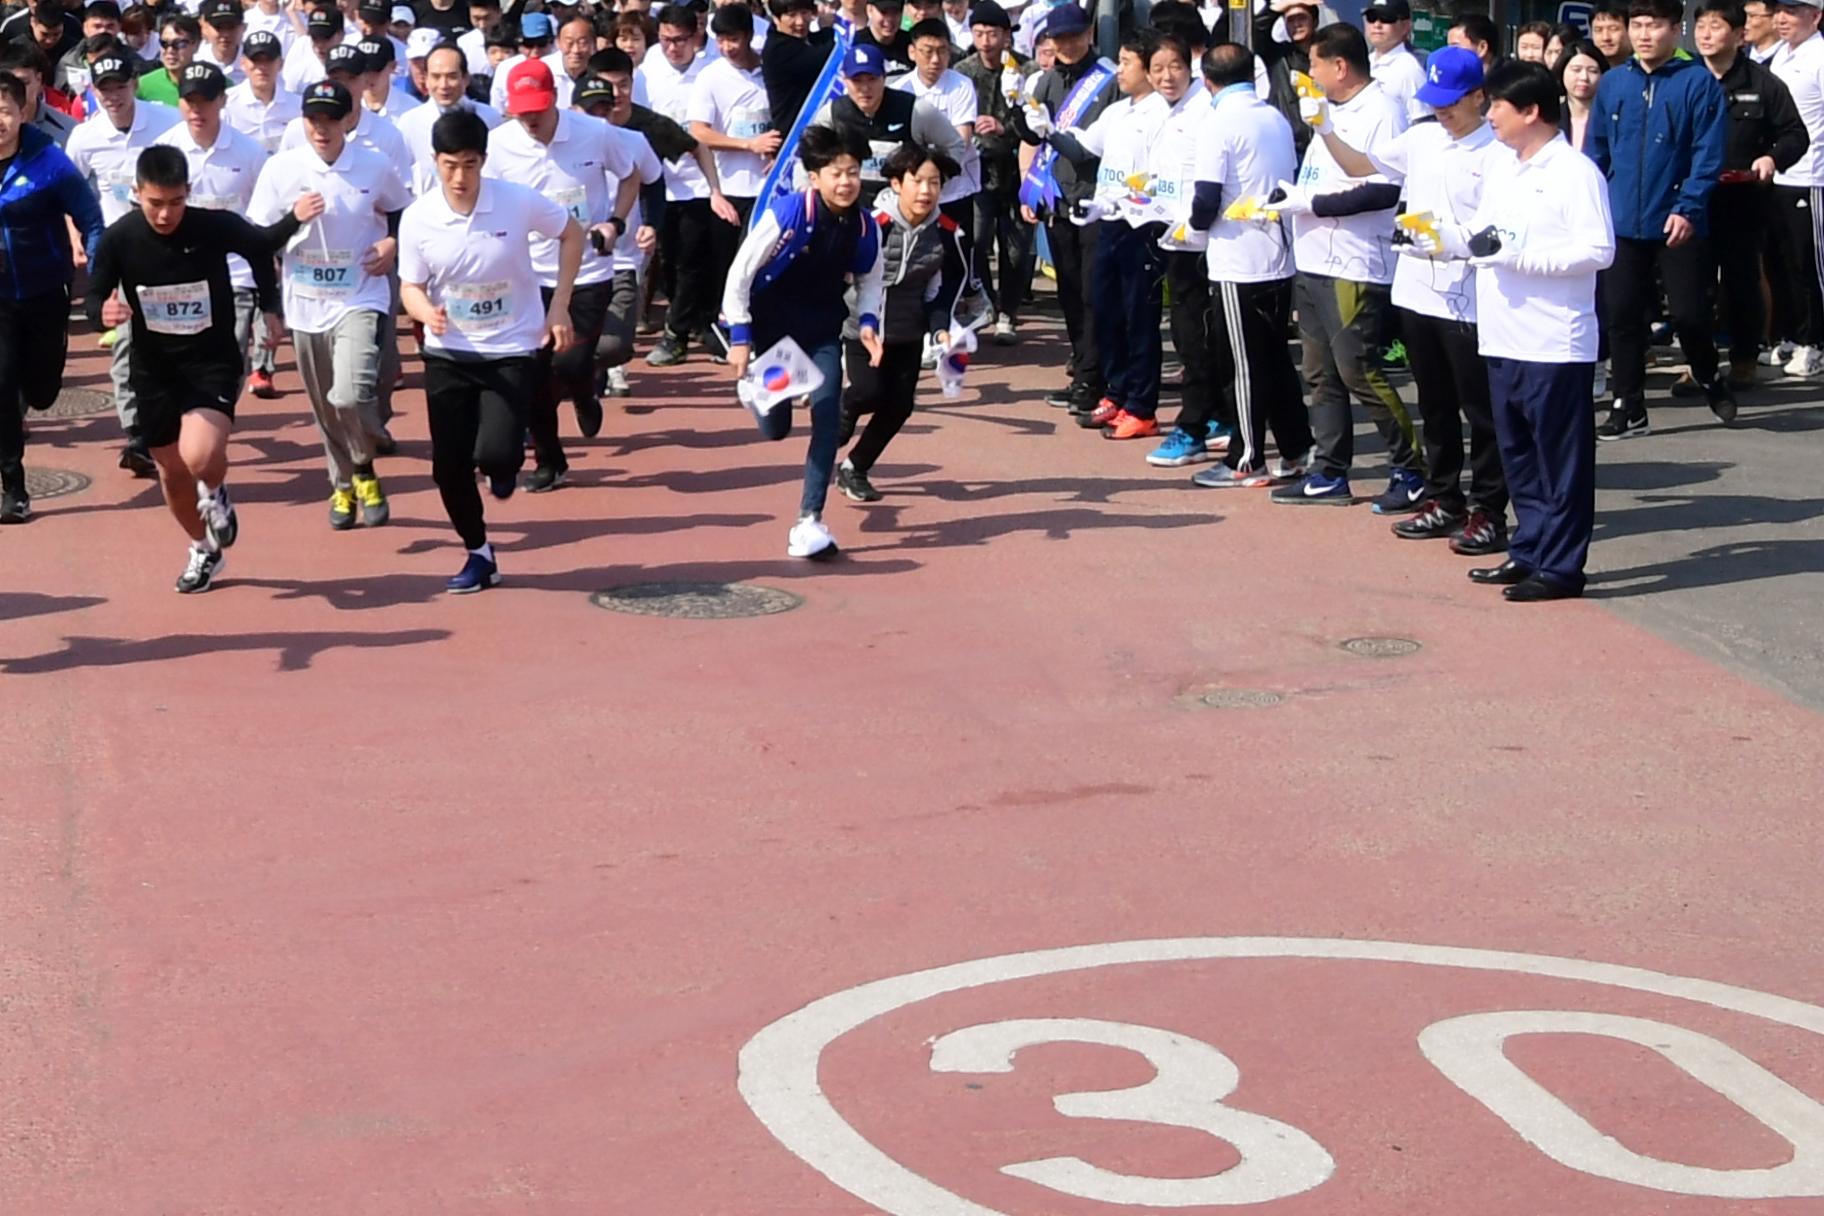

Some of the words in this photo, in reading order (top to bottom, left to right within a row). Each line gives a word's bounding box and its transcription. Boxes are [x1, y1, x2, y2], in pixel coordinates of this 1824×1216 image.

[249, 31, 275, 46] SDT
[94, 56, 124, 75] SDT
[184, 63, 214, 81] SDT
[312, 267, 347, 282] 807
[166, 301, 204, 316] 872
[470, 298, 503, 315] 491
[928, 1010, 1824, 1206] 30
